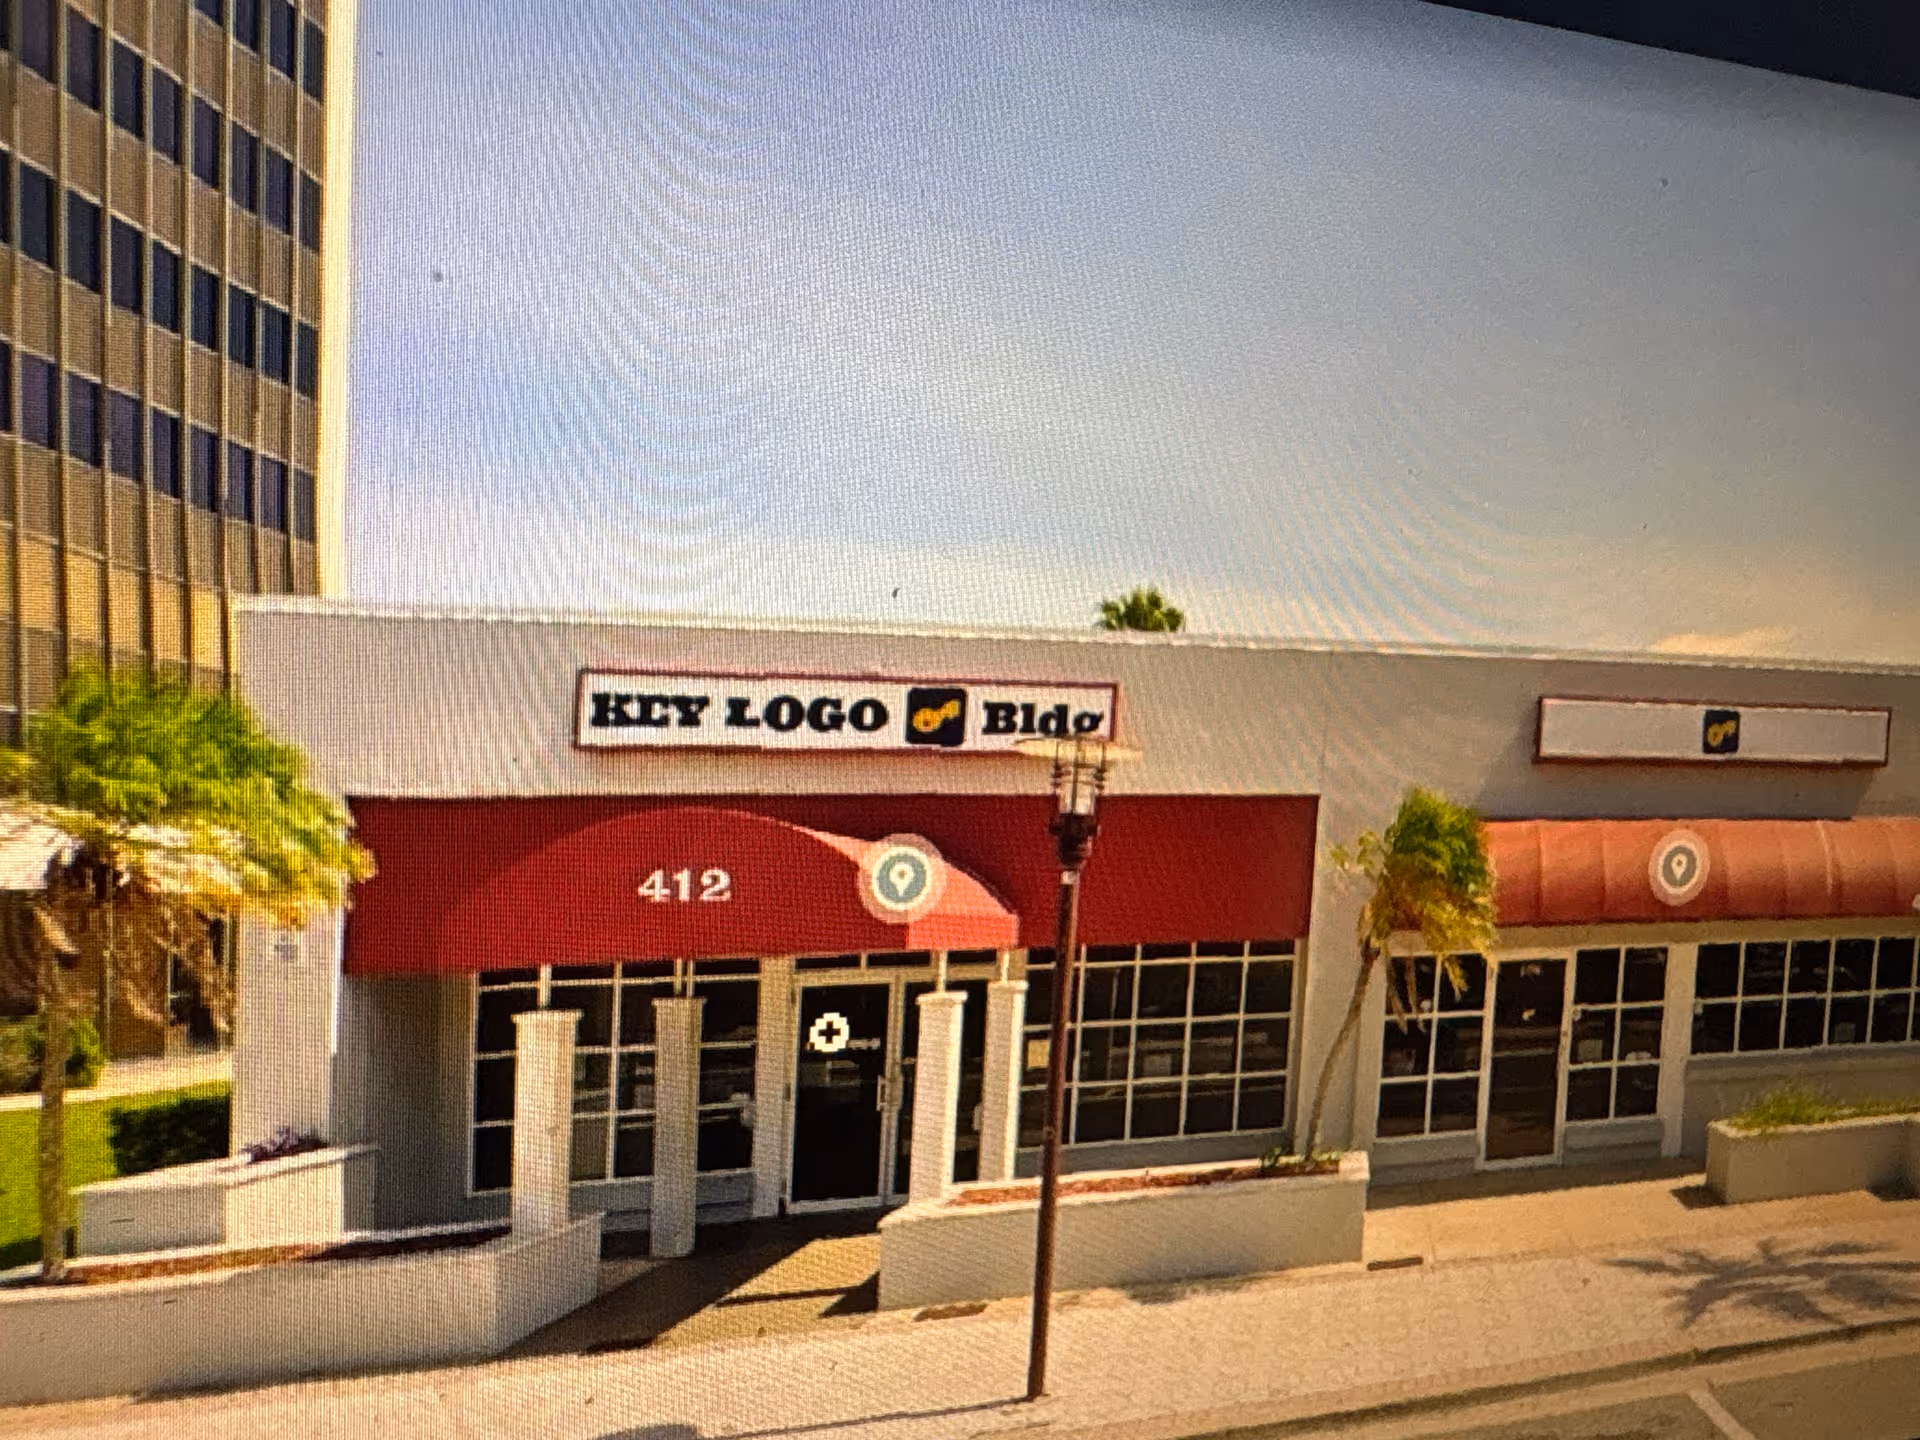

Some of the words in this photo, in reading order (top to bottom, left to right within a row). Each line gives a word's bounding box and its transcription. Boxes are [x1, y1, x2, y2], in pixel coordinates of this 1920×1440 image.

[591, 693, 710, 727] KEY
[725, 695, 888, 732] LOGO
[637, 868, 732, 902] 412
